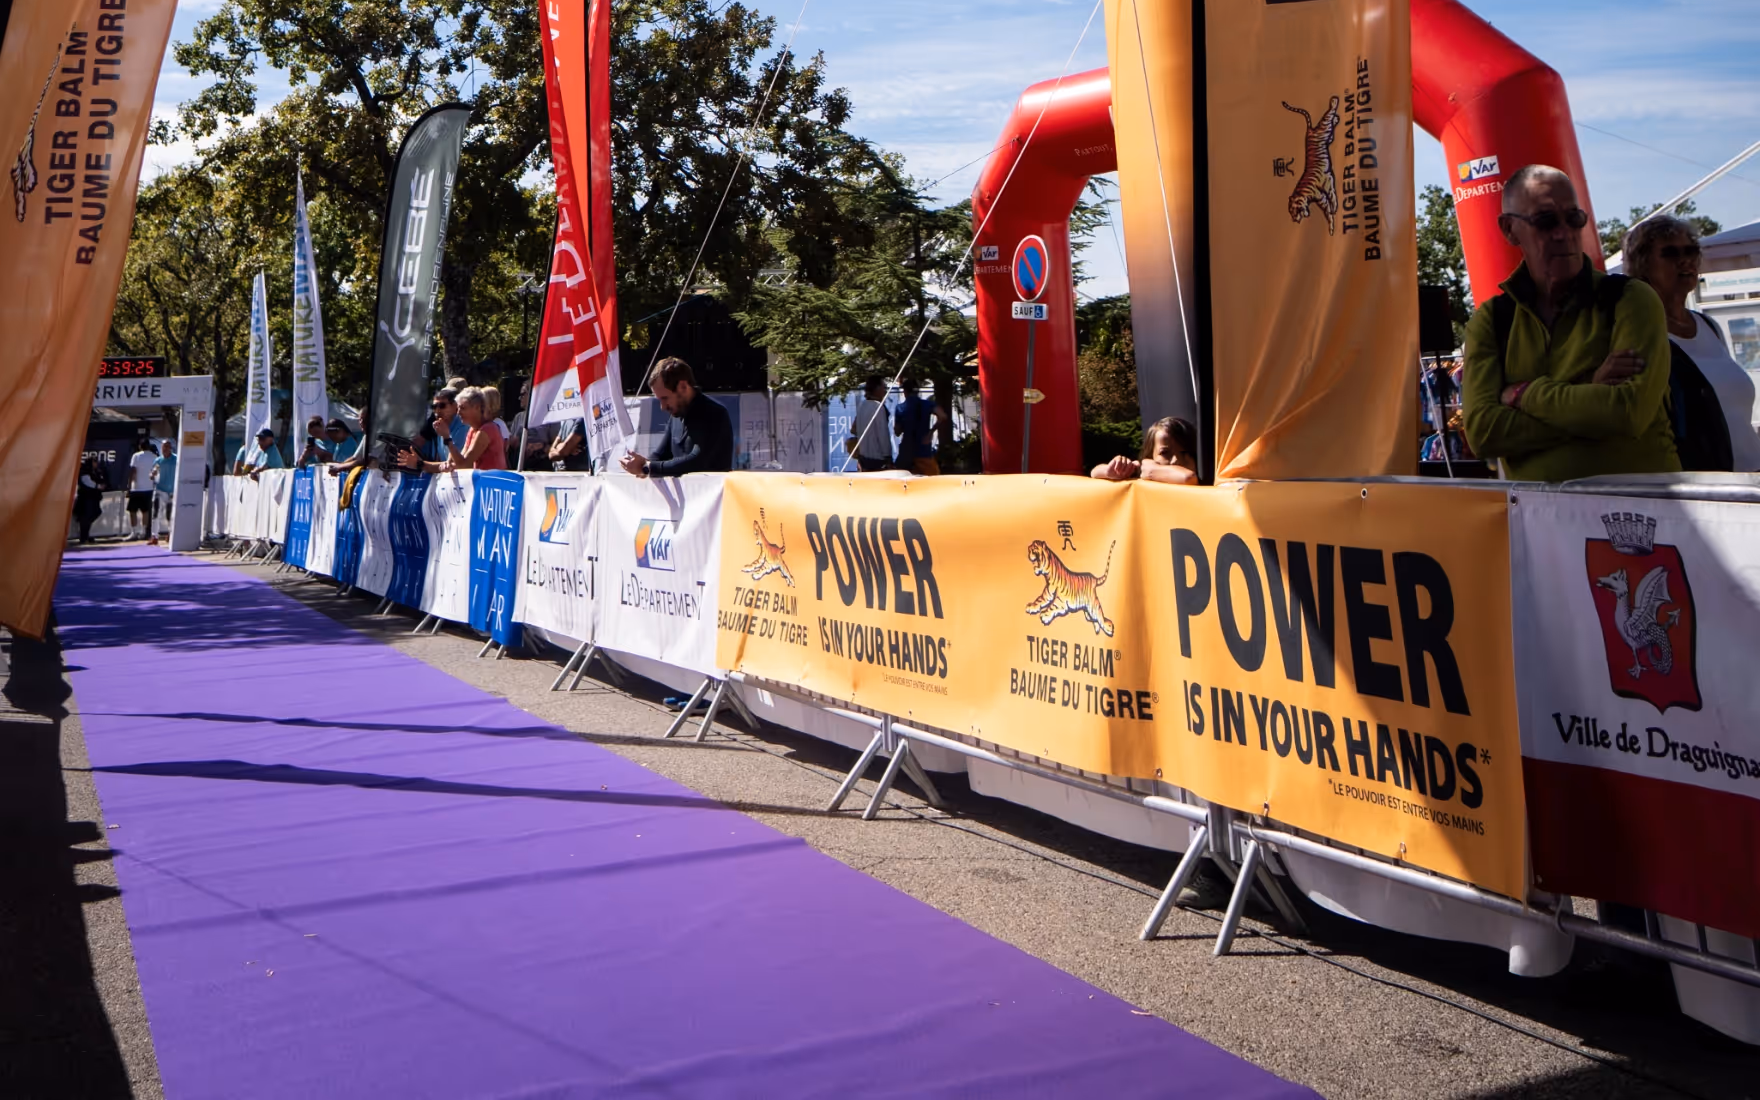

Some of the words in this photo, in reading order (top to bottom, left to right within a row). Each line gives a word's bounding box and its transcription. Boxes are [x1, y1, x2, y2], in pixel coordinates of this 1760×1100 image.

[88, 98, 118, 142] DU
[45, 130, 79, 225] TIGER
[1359, 137, 1378, 170] DU
[75, 153, 112, 265] BAUME
[1342, 163, 1359, 235] TIGER
[1361, 177, 1381, 261] BAUME
[1014, 306, 1034, 317] SAUF
[94, 382, 162, 399] RRIVÉE
[479, 487, 517, 528] NATURE
[805, 513, 944, 620] POWER
[733, 586, 769, 609] TIGER
[772, 595, 798, 617] BALM
[1170, 528, 1471, 716] POWER
[759, 618, 776, 640] DU
[780, 620, 808, 647] TIGRE
[818, 616, 831, 653] IS
[831, 620, 844, 658] IN
[846, 623, 887, 668] YOUR
[1026, 635, 1068, 669] TIGER
[1010, 668, 1056, 704] BAUME
[1061, 680, 1080, 711] DU
[1183, 680, 1205, 736] IS
[1210, 687, 1247, 746] IN
[1249, 694, 1341, 773] YOUR
[1552, 712, 1612, 750] Ville
[1616, 723, 1641, 754] de
[1646, 726, 1760, 779] Draguigna
[1346, 785, 1386, 807] POUVOIR
[1388, 795, 1401, 811] EST
[1403, 801, 1429, 821] ENTRE
[1429, 809, 1450, 827] VOS
[1451, 815, 1485, 836] MAINS
